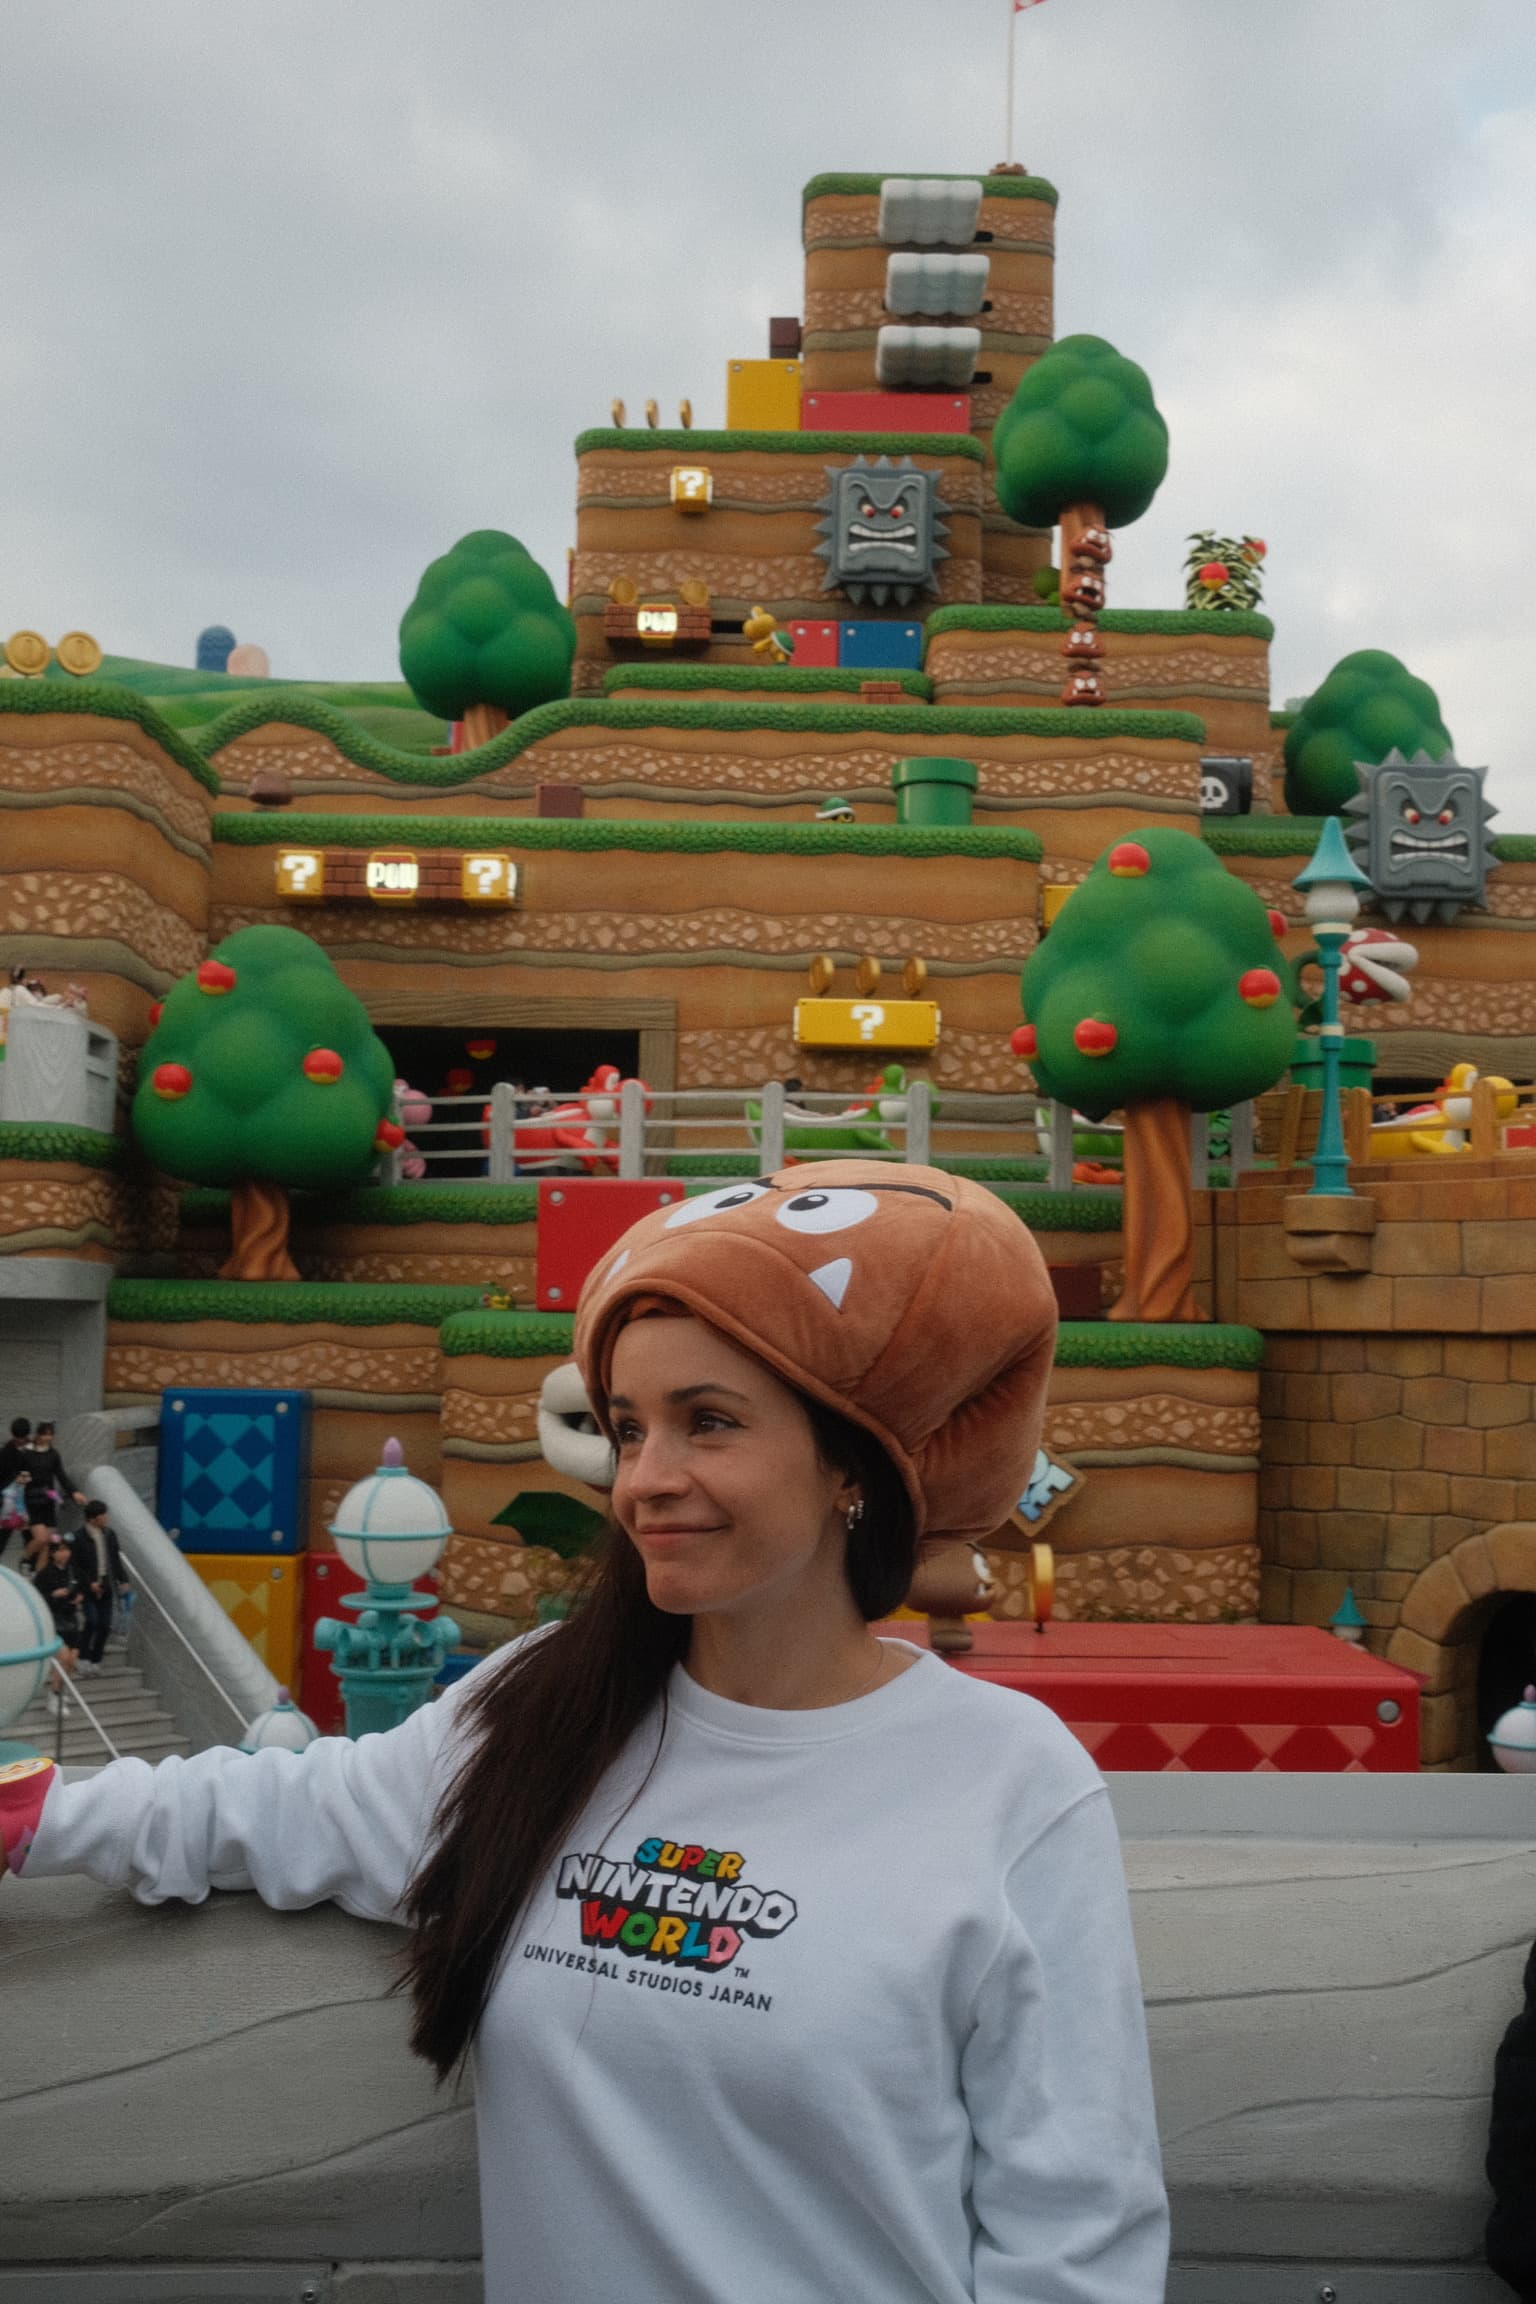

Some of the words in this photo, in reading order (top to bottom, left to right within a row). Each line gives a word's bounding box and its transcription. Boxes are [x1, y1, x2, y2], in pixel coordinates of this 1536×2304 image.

[679, 470, 704, 497] ?
[282, 855, 317, 891] ?
[468, 859, 503, 895] ?
[851, 1004, 885, 1040] ?
[634, 1837, 747, 1880] SUPER
[556, 1853, 798, 1938] NINTENDO
[581, 1900, 743, 1973] WORLD
[523, 1944, 619, 1980] UNIVERSAL
[626, 1969, 703, 1998] STUDIOS
[709, 1985, 773, 2012] JAPAN
